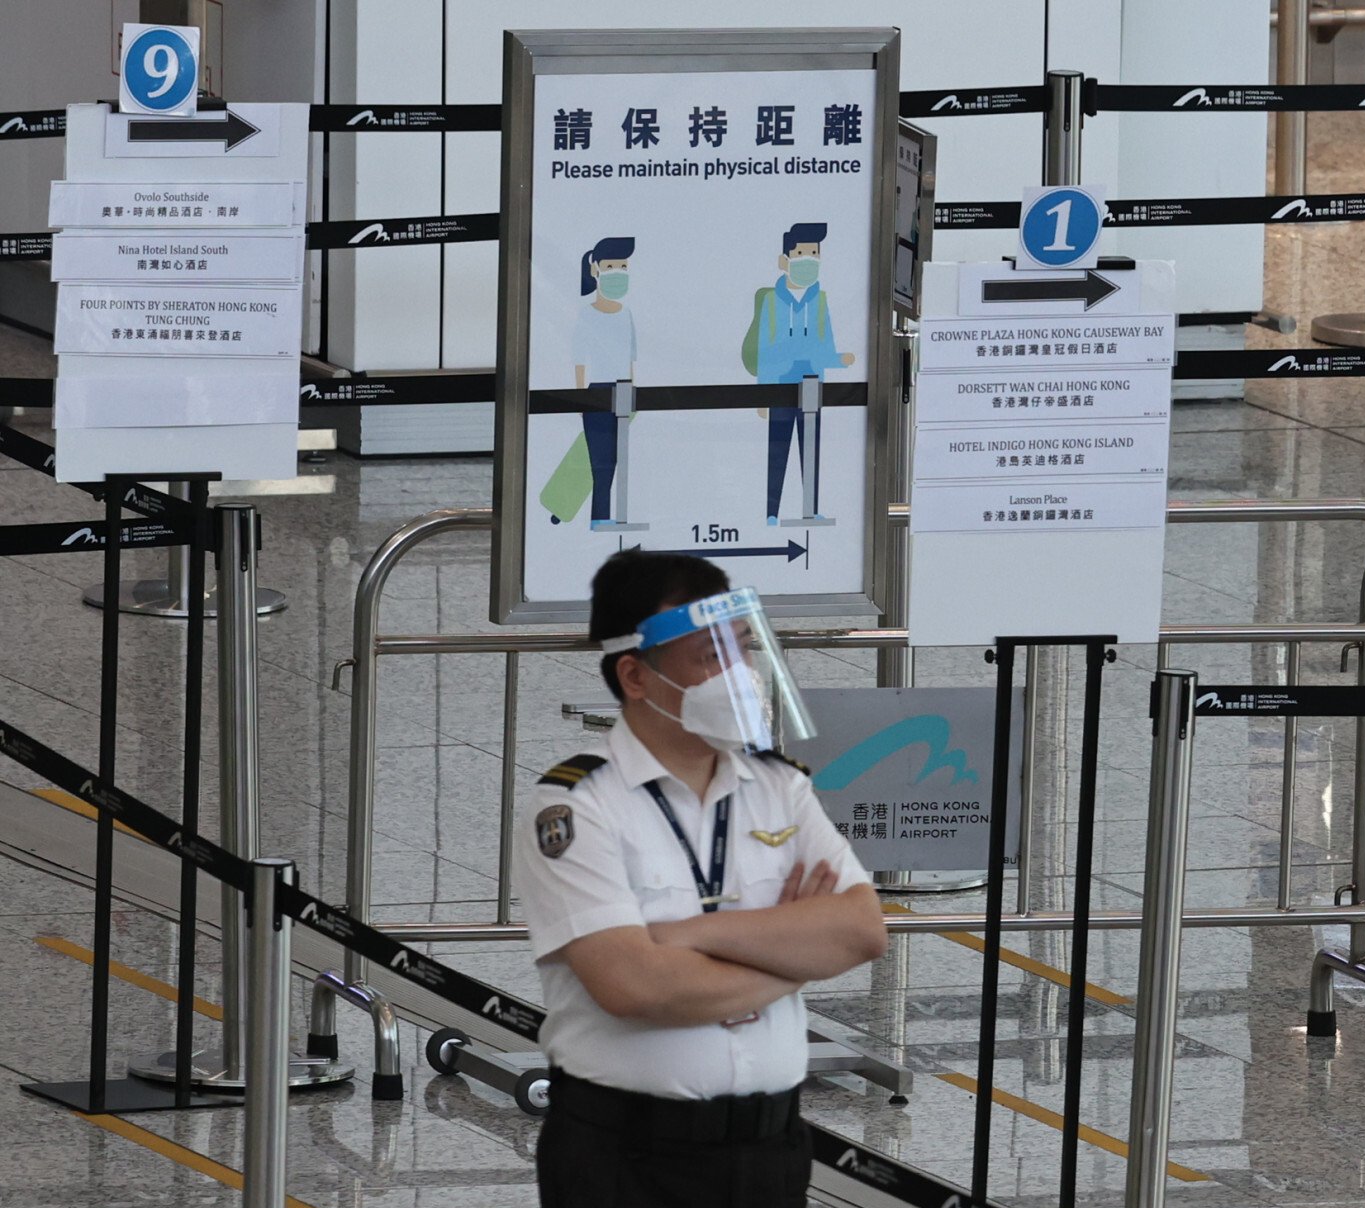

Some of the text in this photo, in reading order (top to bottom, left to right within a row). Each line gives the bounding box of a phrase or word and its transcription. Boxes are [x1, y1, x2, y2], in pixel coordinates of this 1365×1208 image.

[142, 44, 180, 99] 9
[553, 103, 862, 150] 請保持距離
[552, 156, 861, 180] Please maintain physical distance
[134, 191, 209, 202] Ovolo Southside
[1043, 199, 1076, 252] 1
[118, 244, 228, 254] Nina Hotel Island South
[137, 259, 207, 270] 南灣如心酒店
[80, 299, 277, 312] FOUR POINTS BY SHERATON HONG KONG
[145, 314, 210, 325] TUNG CHUNG
[930, 326, 1164, 342] CROWNE PLAZA HONG KONG CAUSEWAY BAY
[957, 380, 1130, 394] DORSETT WAN CHAI HONG KONG
[949, 437, 1134, 452] HOTEL INDIGO HONG KONG ISLAND
[1009, 494, 1068, 505] Lanson Place
[691, 524, 739, 543] 1.5m
[853, 803, 888, 820] 香港
[901, 801, 980, 811] HONG KONG
[901, 815, 992, 824] INTERNATION
[834, 823, 888, 840] 際機場
[901, 829, 957, 838] AIRPORT
